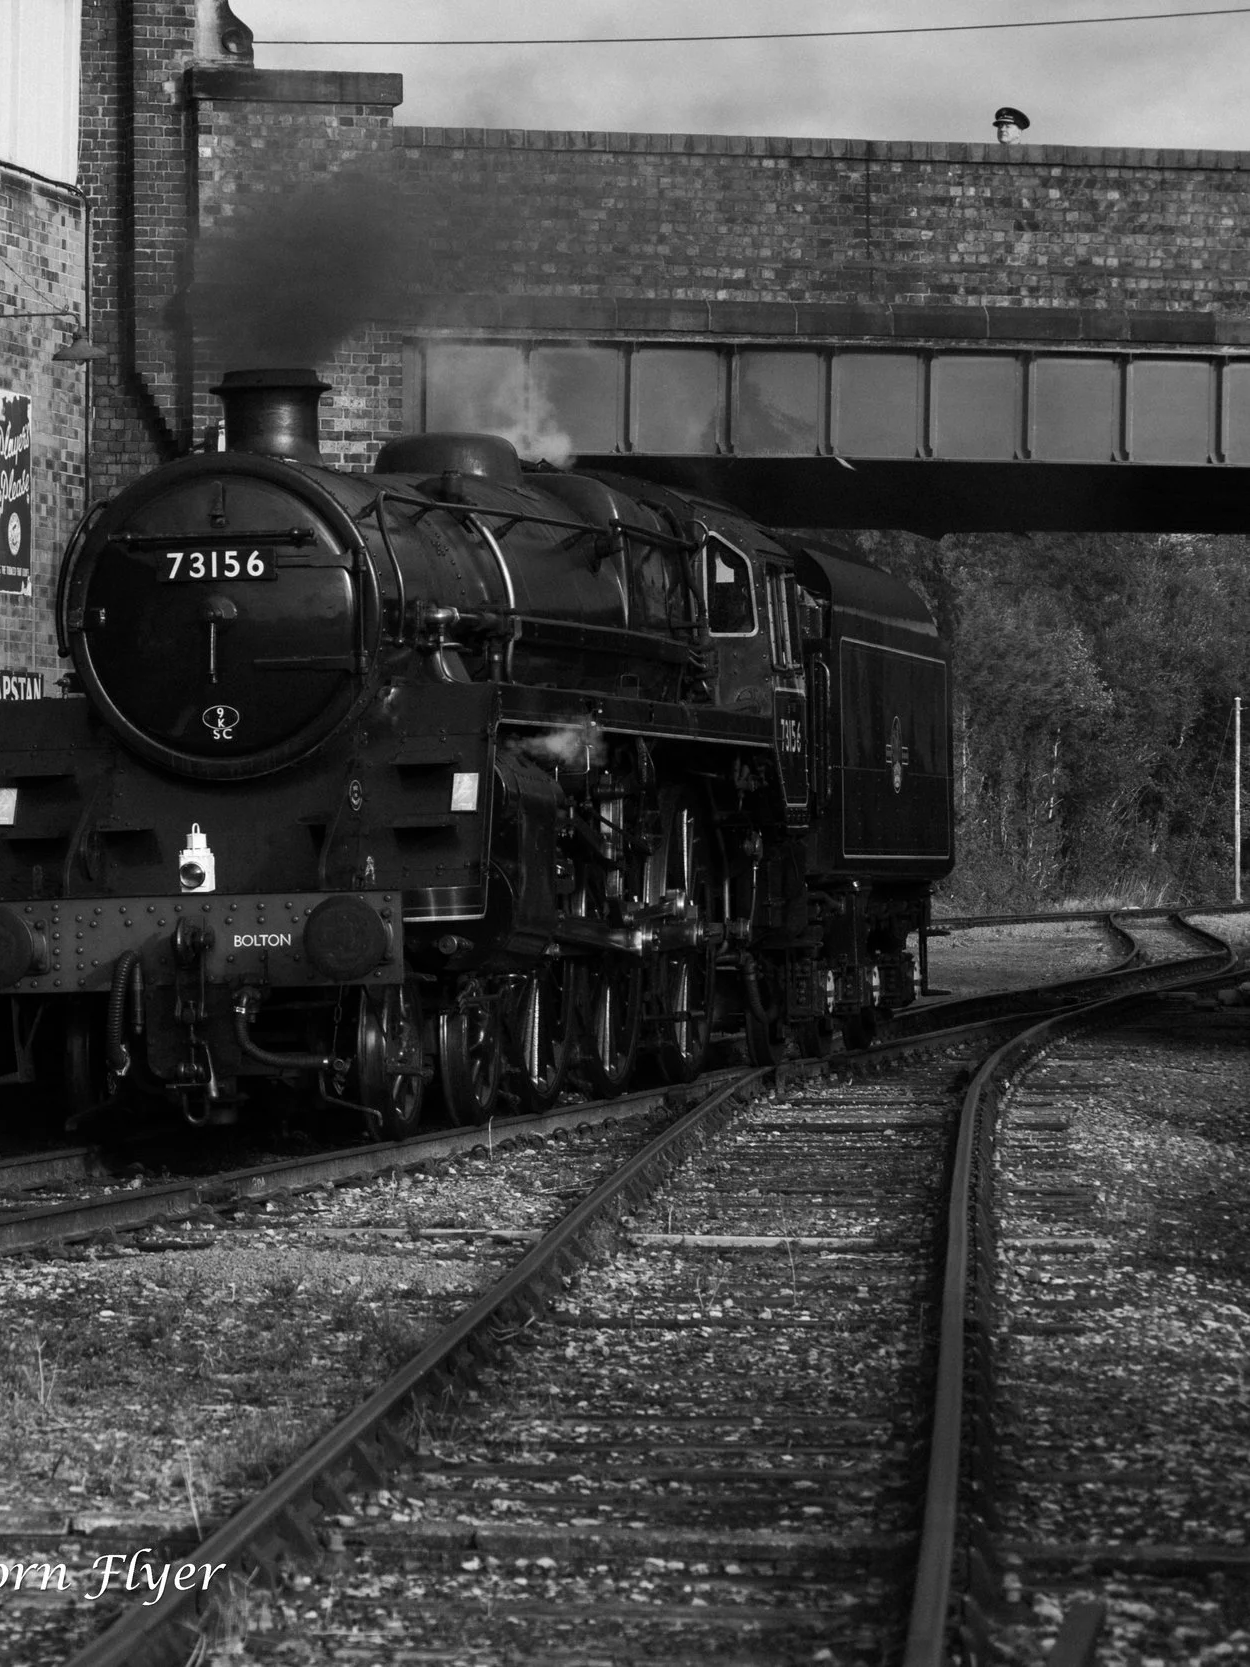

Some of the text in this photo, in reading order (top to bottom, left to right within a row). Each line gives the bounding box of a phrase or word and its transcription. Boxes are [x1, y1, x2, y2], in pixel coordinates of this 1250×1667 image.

[0, 468, 30, 514] Please
[166, 550, 265, 579] 73156
[216, 707, 225, 718] 9
[217, 718, 225, 728] K
[213, 729, 233, 739] SC
[780, 718, 802, 752] 73156
[234, 933, 291, 947] BOLTON
